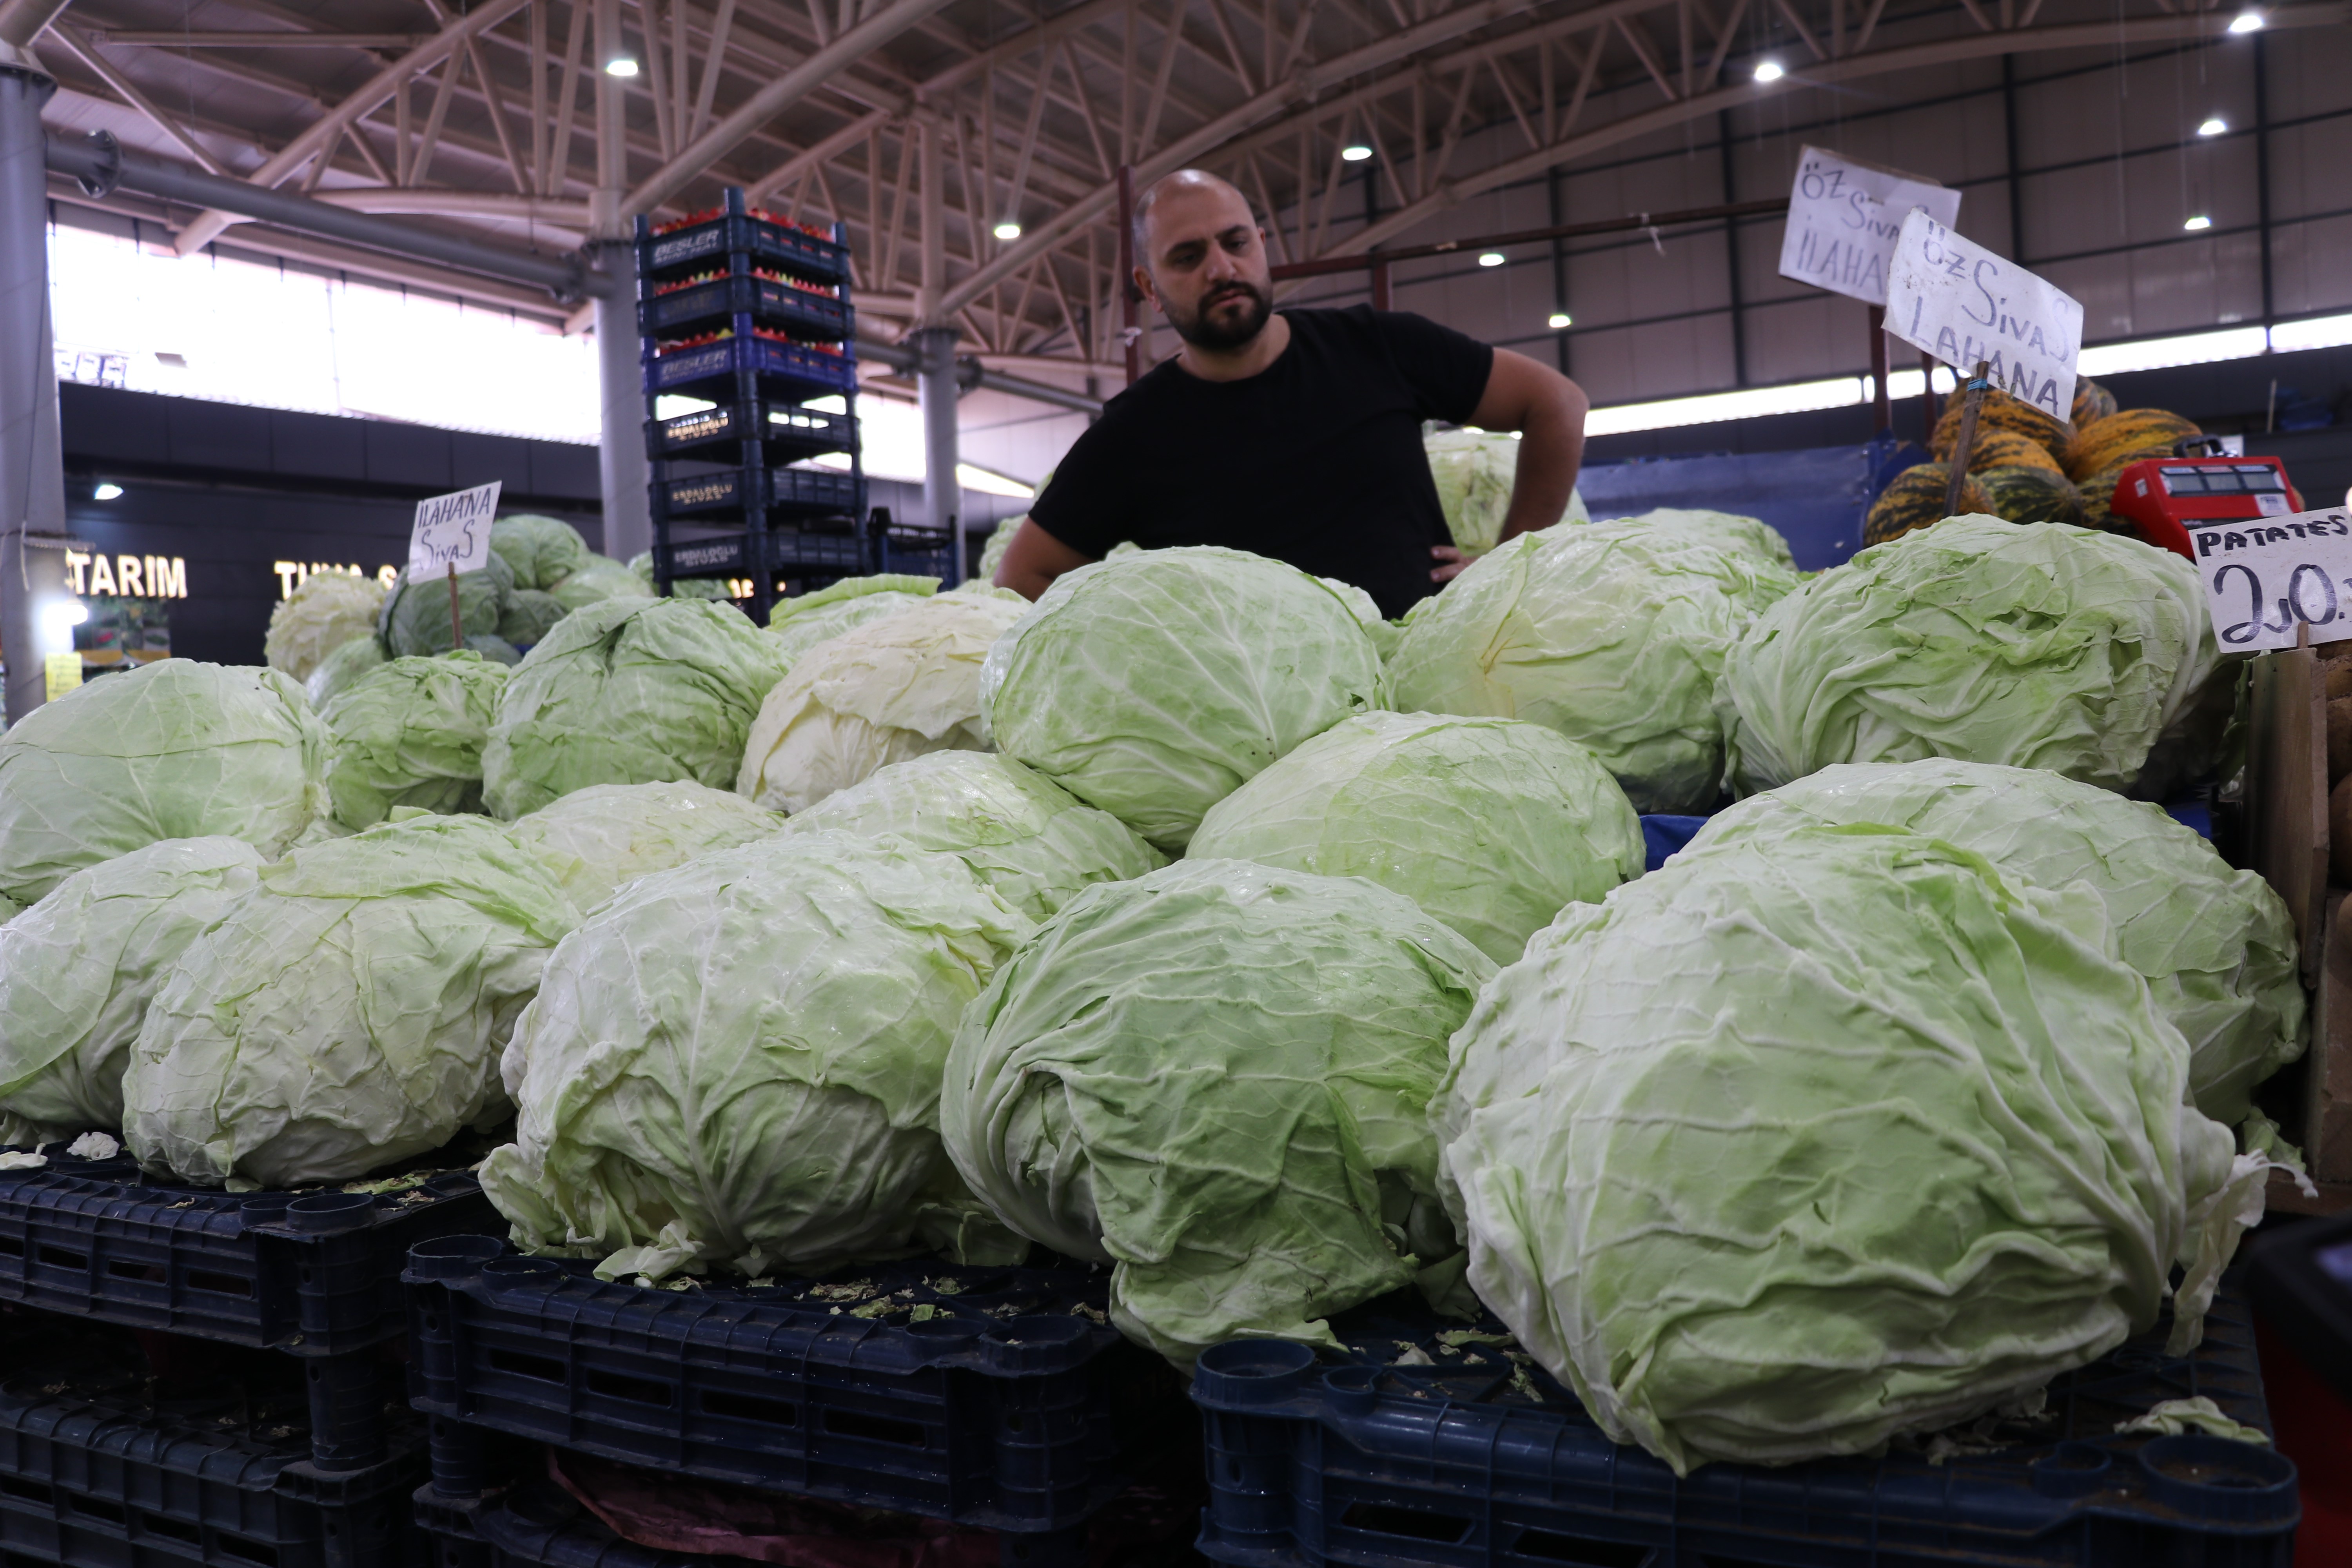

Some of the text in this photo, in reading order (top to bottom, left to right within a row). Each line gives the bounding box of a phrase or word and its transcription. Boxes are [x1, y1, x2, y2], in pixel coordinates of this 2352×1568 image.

[655, 229, 719, 257] BESLER
[1924, 220, 1966, 279] ÖZ
[1909, 296, 2058, 416] LAHANA
[2197, 515, 2348, 557] PATATES
[69, 552, 188, 599] TARIM
